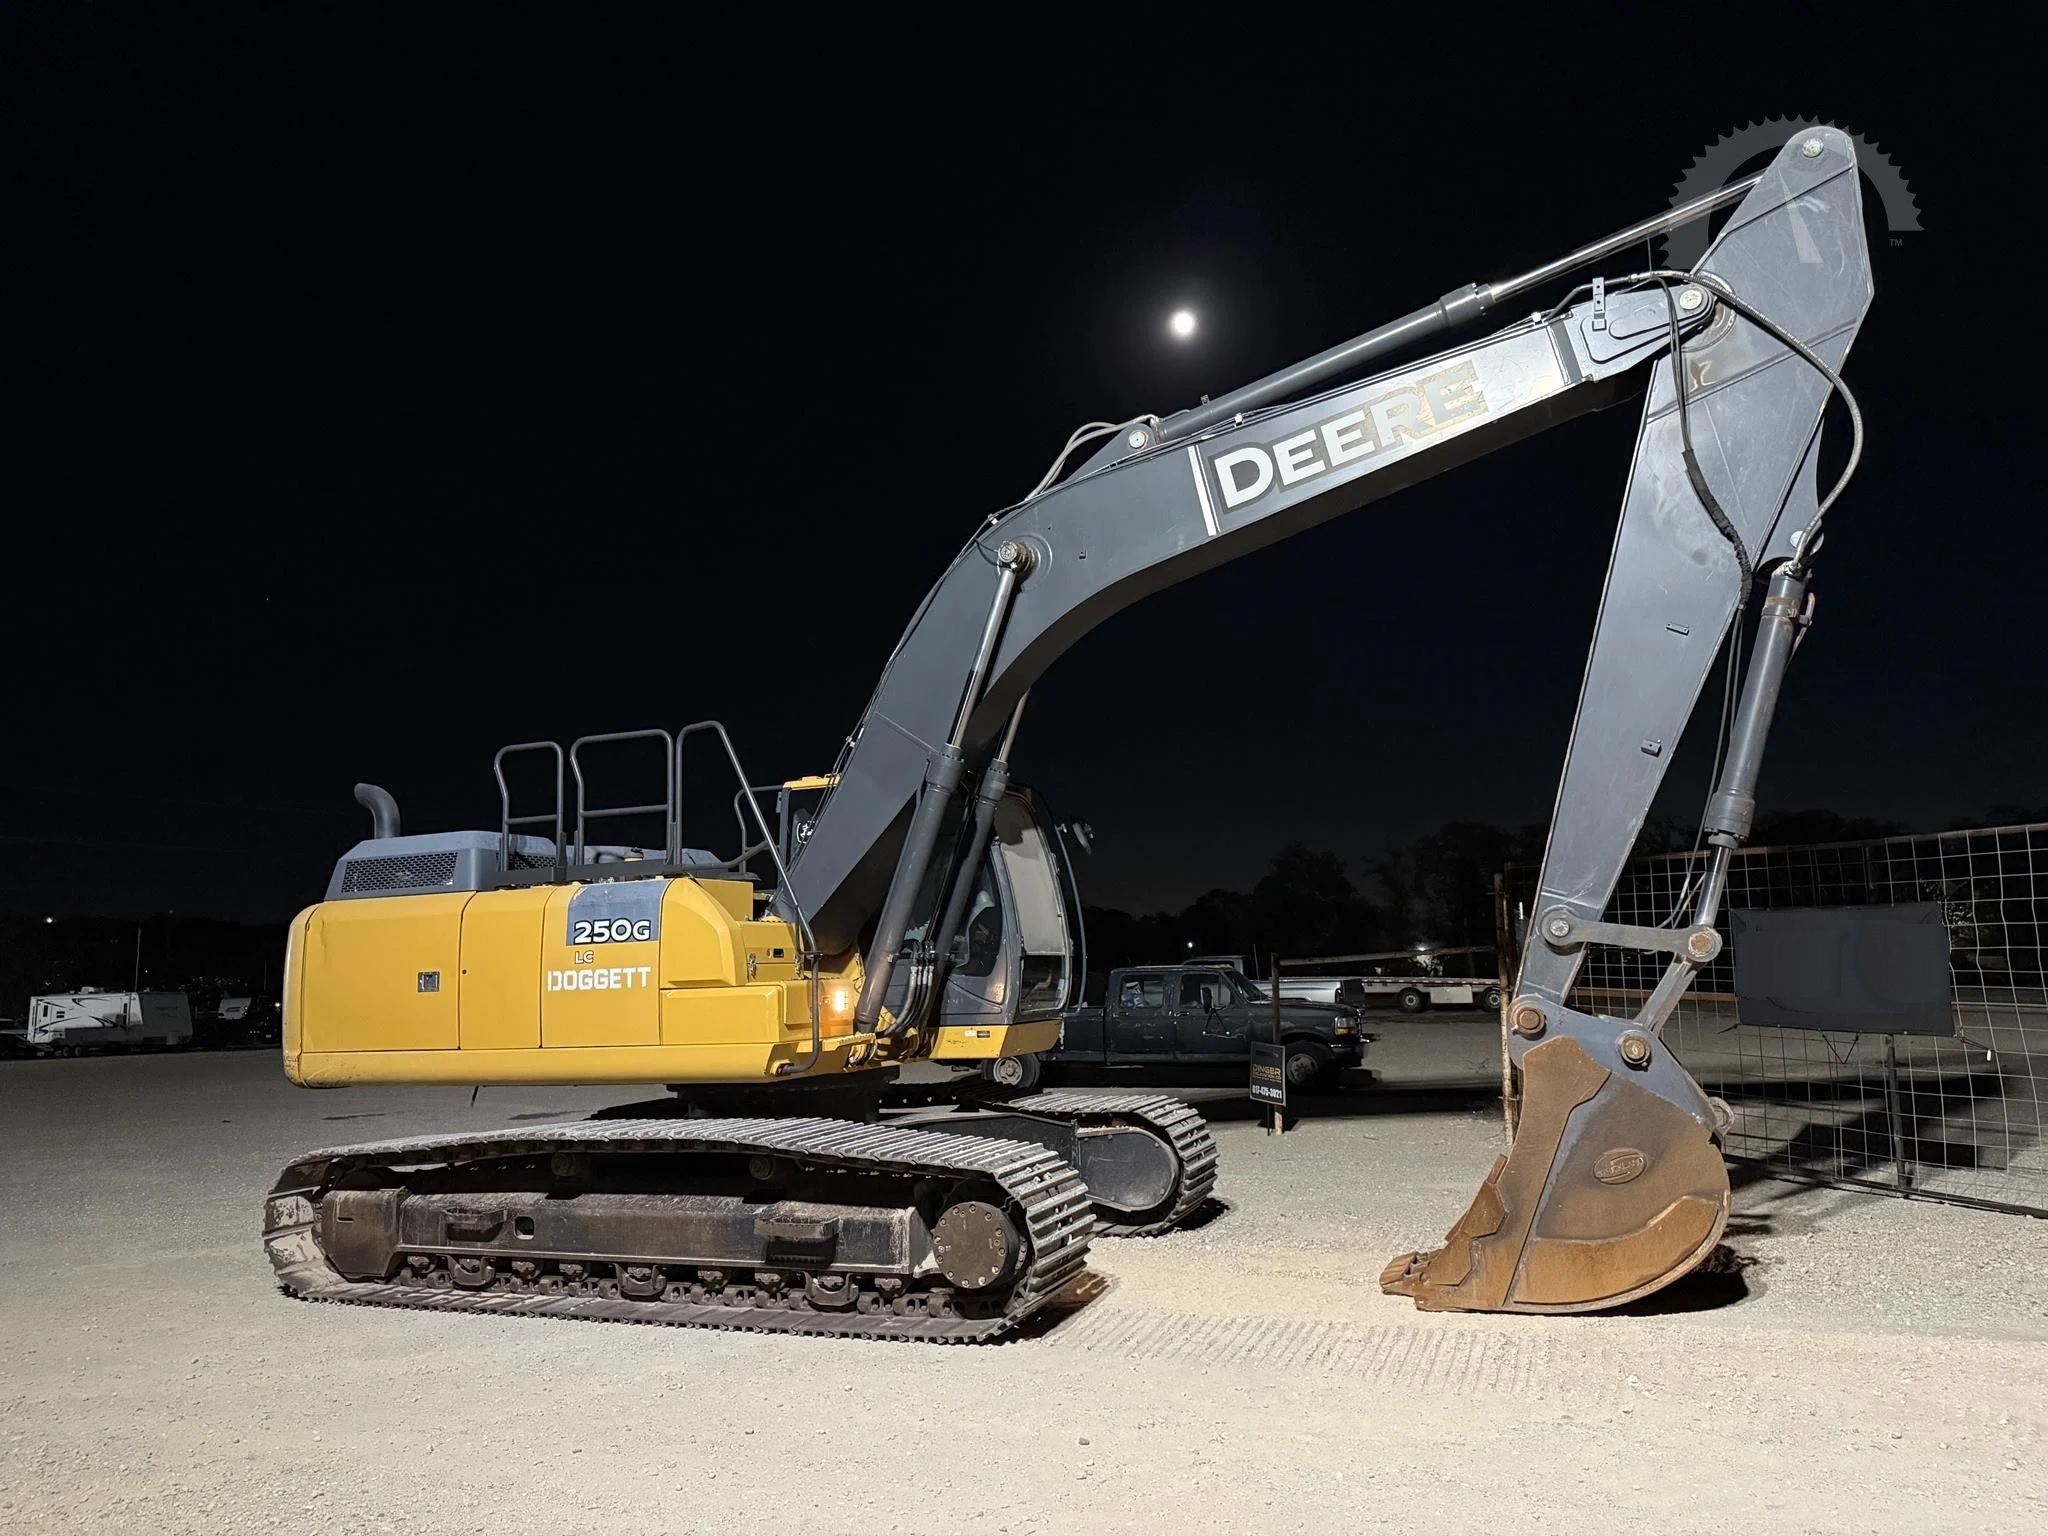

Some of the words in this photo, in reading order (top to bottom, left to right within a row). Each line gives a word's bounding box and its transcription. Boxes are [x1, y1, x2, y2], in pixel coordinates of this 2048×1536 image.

[1211, 361, 1487, 511] DEERE
[574, 918, 651, 944] 250G
[575, 950, 594, 964] LC
[547, 966, 651, 992] DOGGETT
